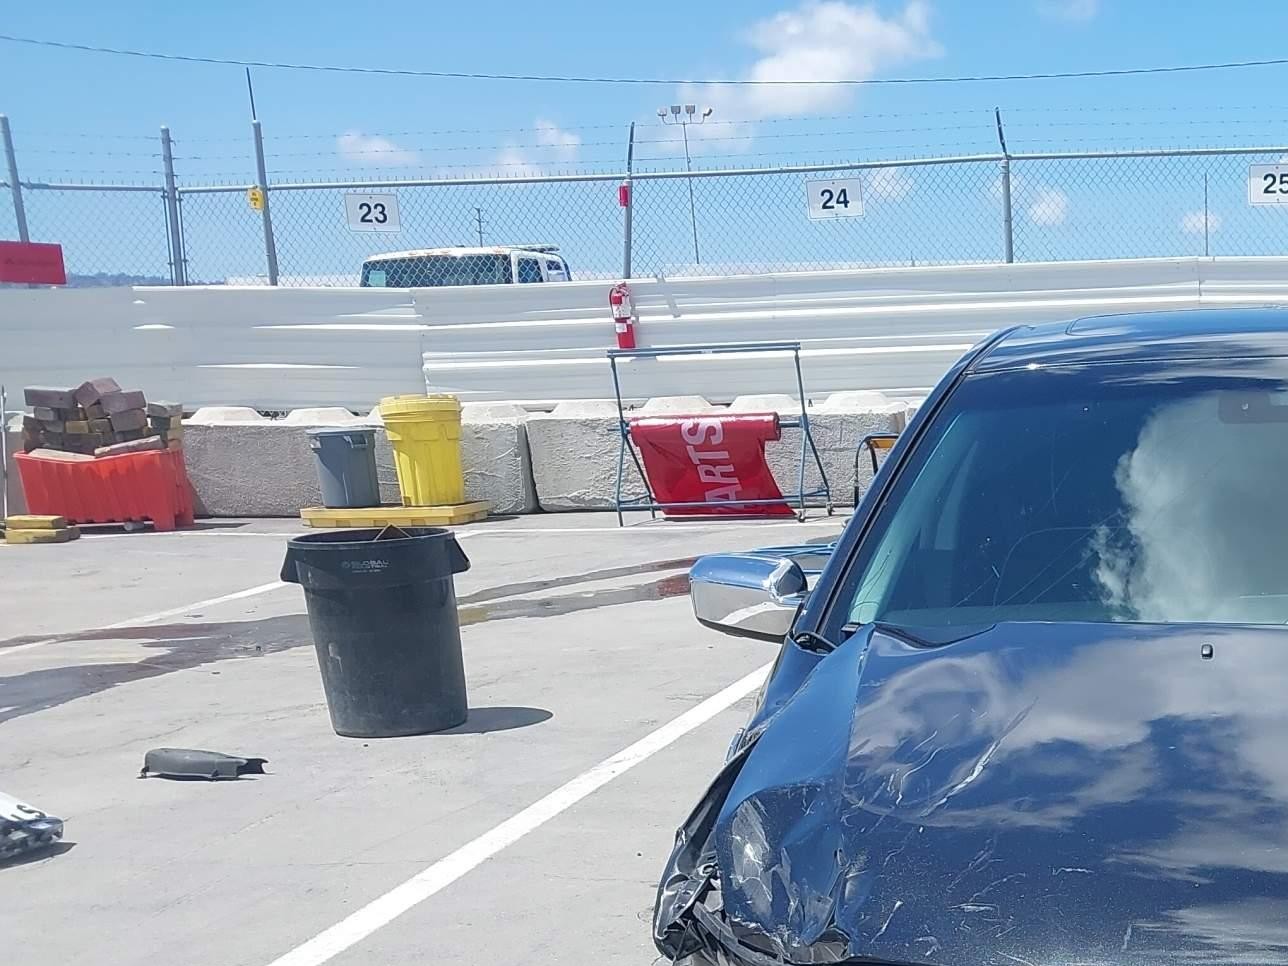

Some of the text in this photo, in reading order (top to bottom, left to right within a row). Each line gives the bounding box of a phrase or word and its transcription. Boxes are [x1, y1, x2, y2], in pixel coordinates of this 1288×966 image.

[820, 187, 850, 210] 24
[358, 202, 388, 224] 23
[681, 419, 745, 509] ARTS
